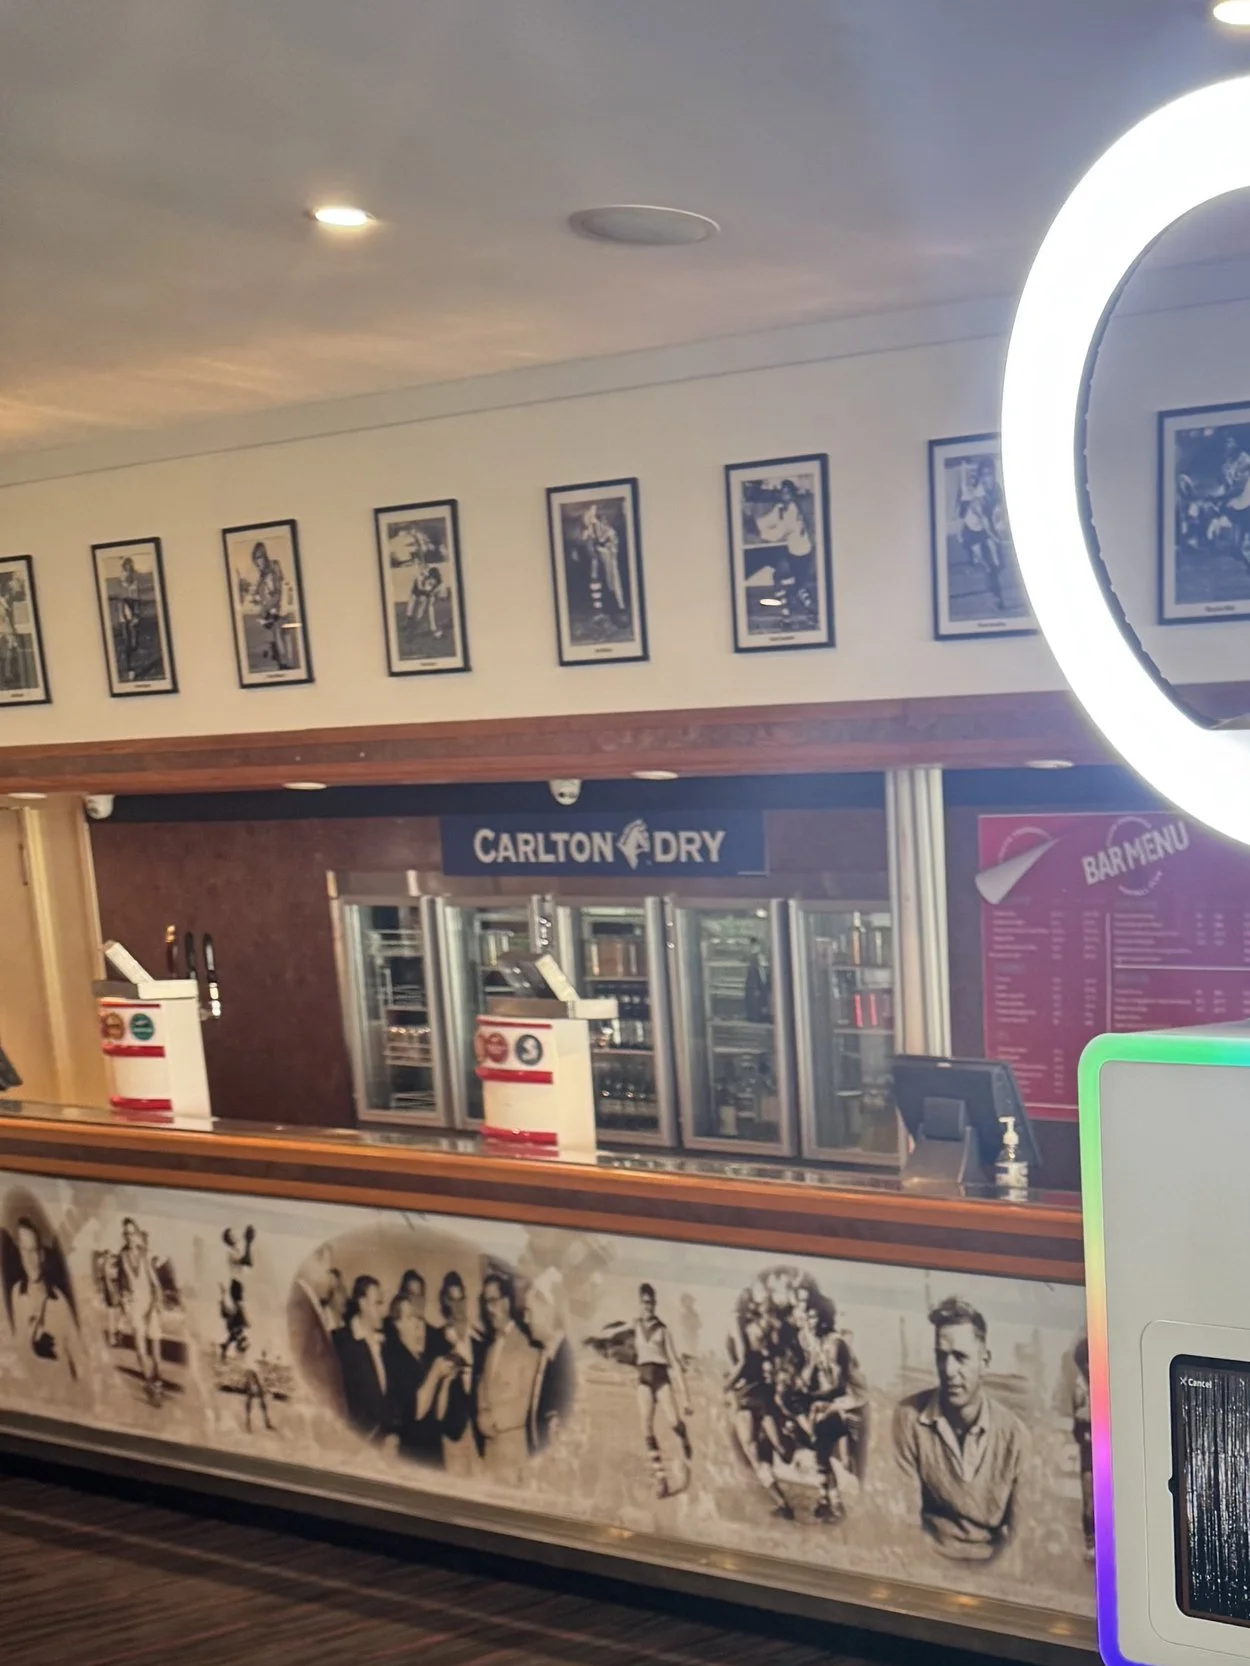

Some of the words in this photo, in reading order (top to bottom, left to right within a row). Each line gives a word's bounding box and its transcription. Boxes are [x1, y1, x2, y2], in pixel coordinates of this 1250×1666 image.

[473, 828, 614, 863] CARLTON
[654, 831, 726, 862] DRY
[1187, 1377, 1213, 1389] Cancel
